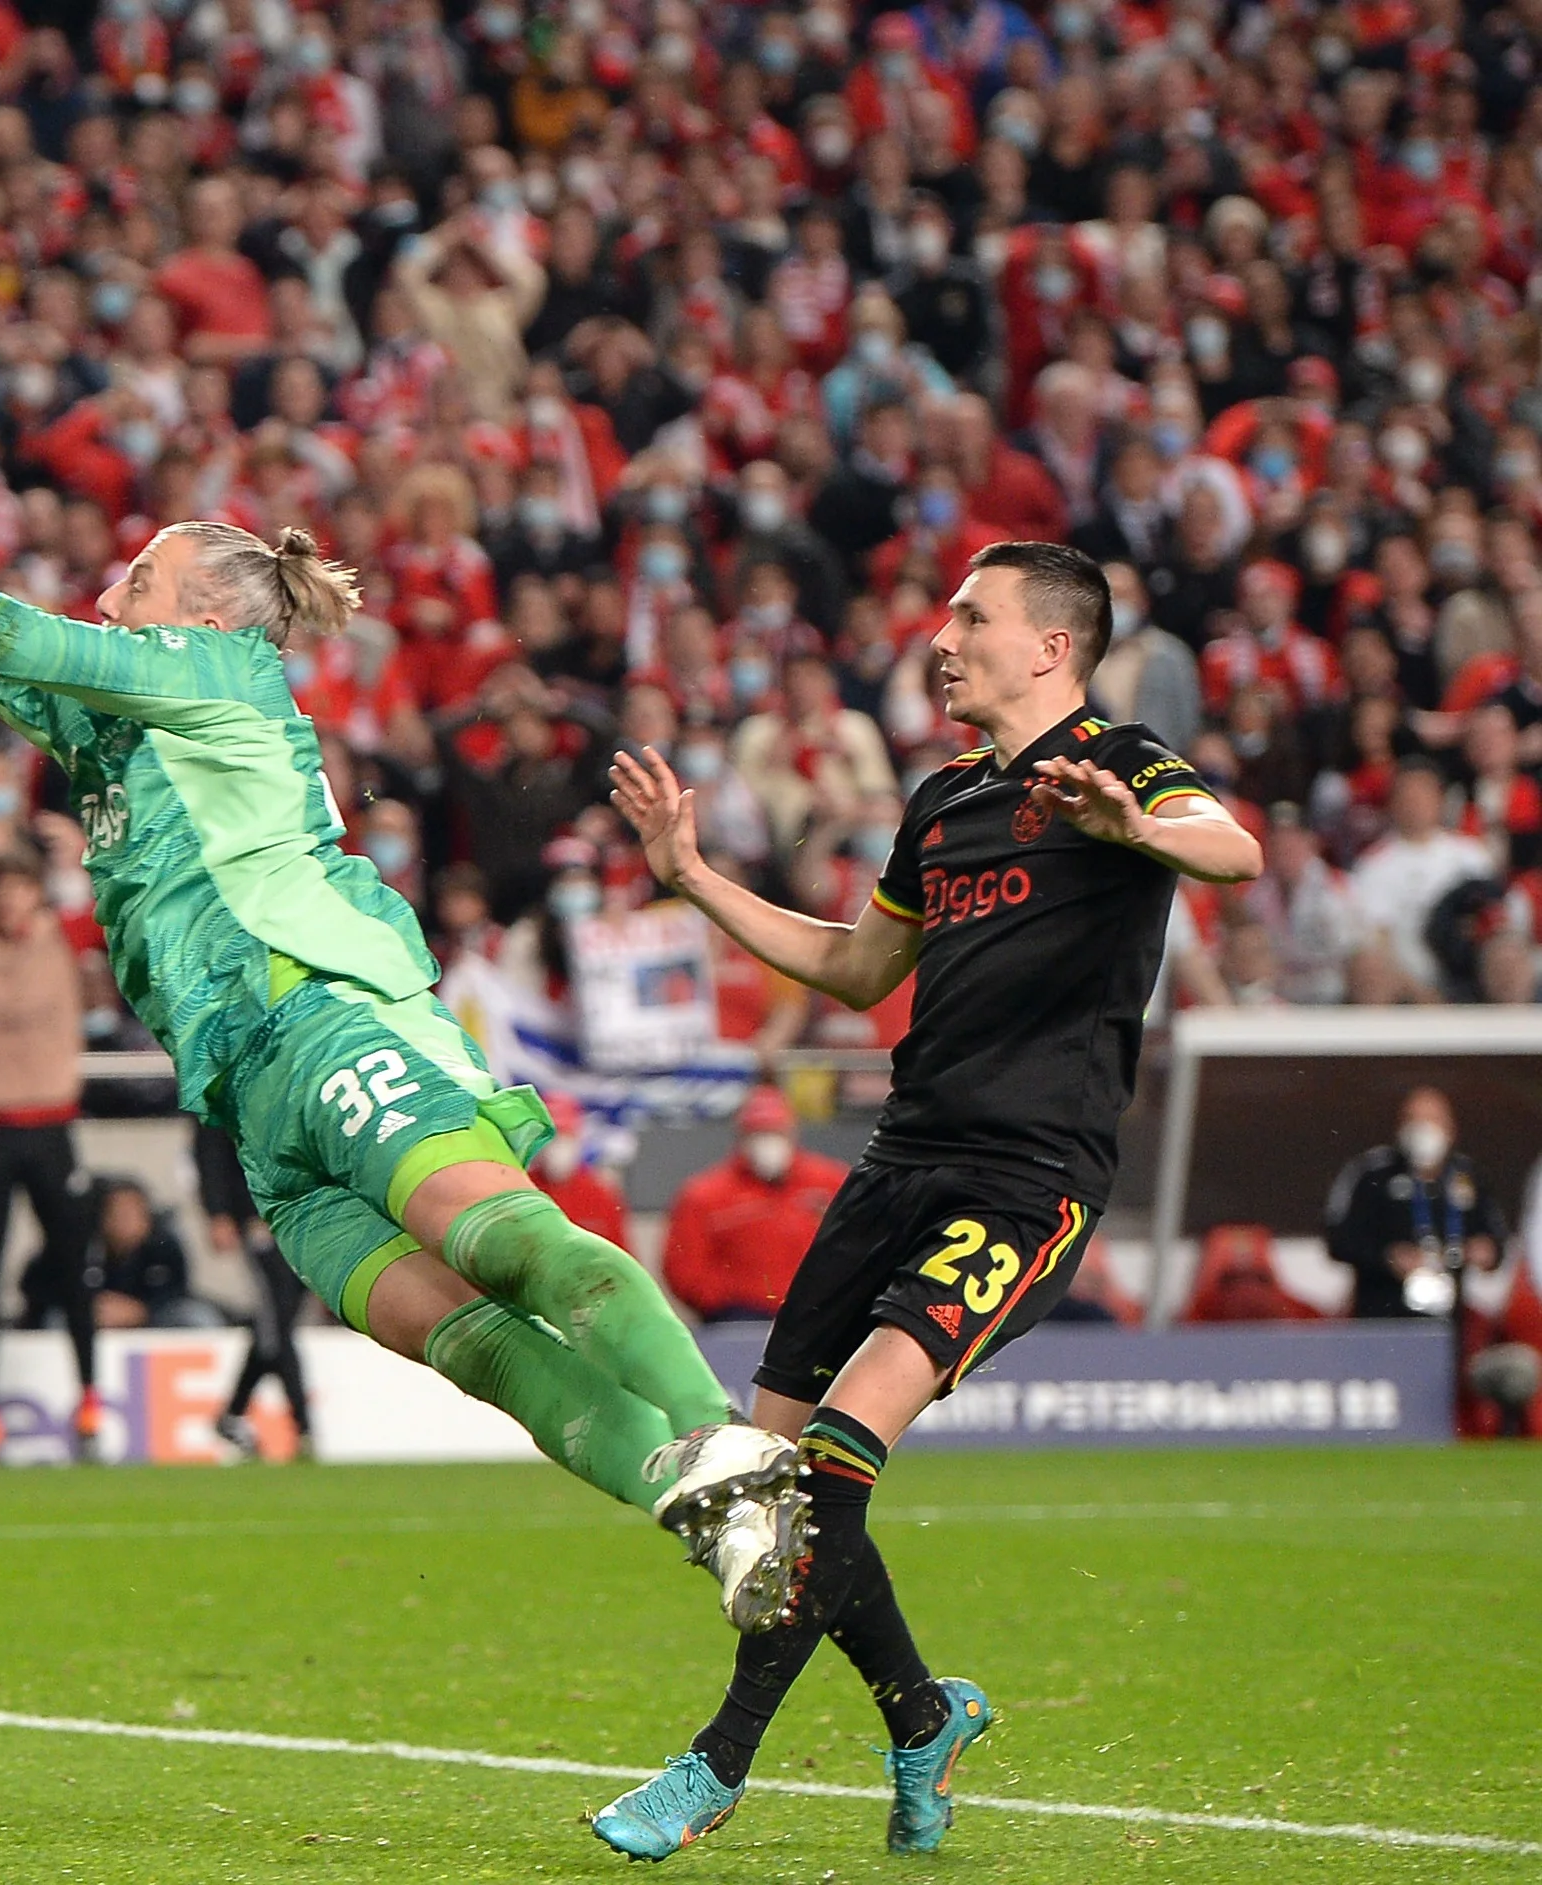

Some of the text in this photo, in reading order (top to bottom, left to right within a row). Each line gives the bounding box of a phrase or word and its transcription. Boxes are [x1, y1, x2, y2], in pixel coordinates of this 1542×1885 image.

[320, 1048, 421, 1137] 32
[918, 1219, 1021, 1314] 23
[926, 1305, 959, 1339] adidas
